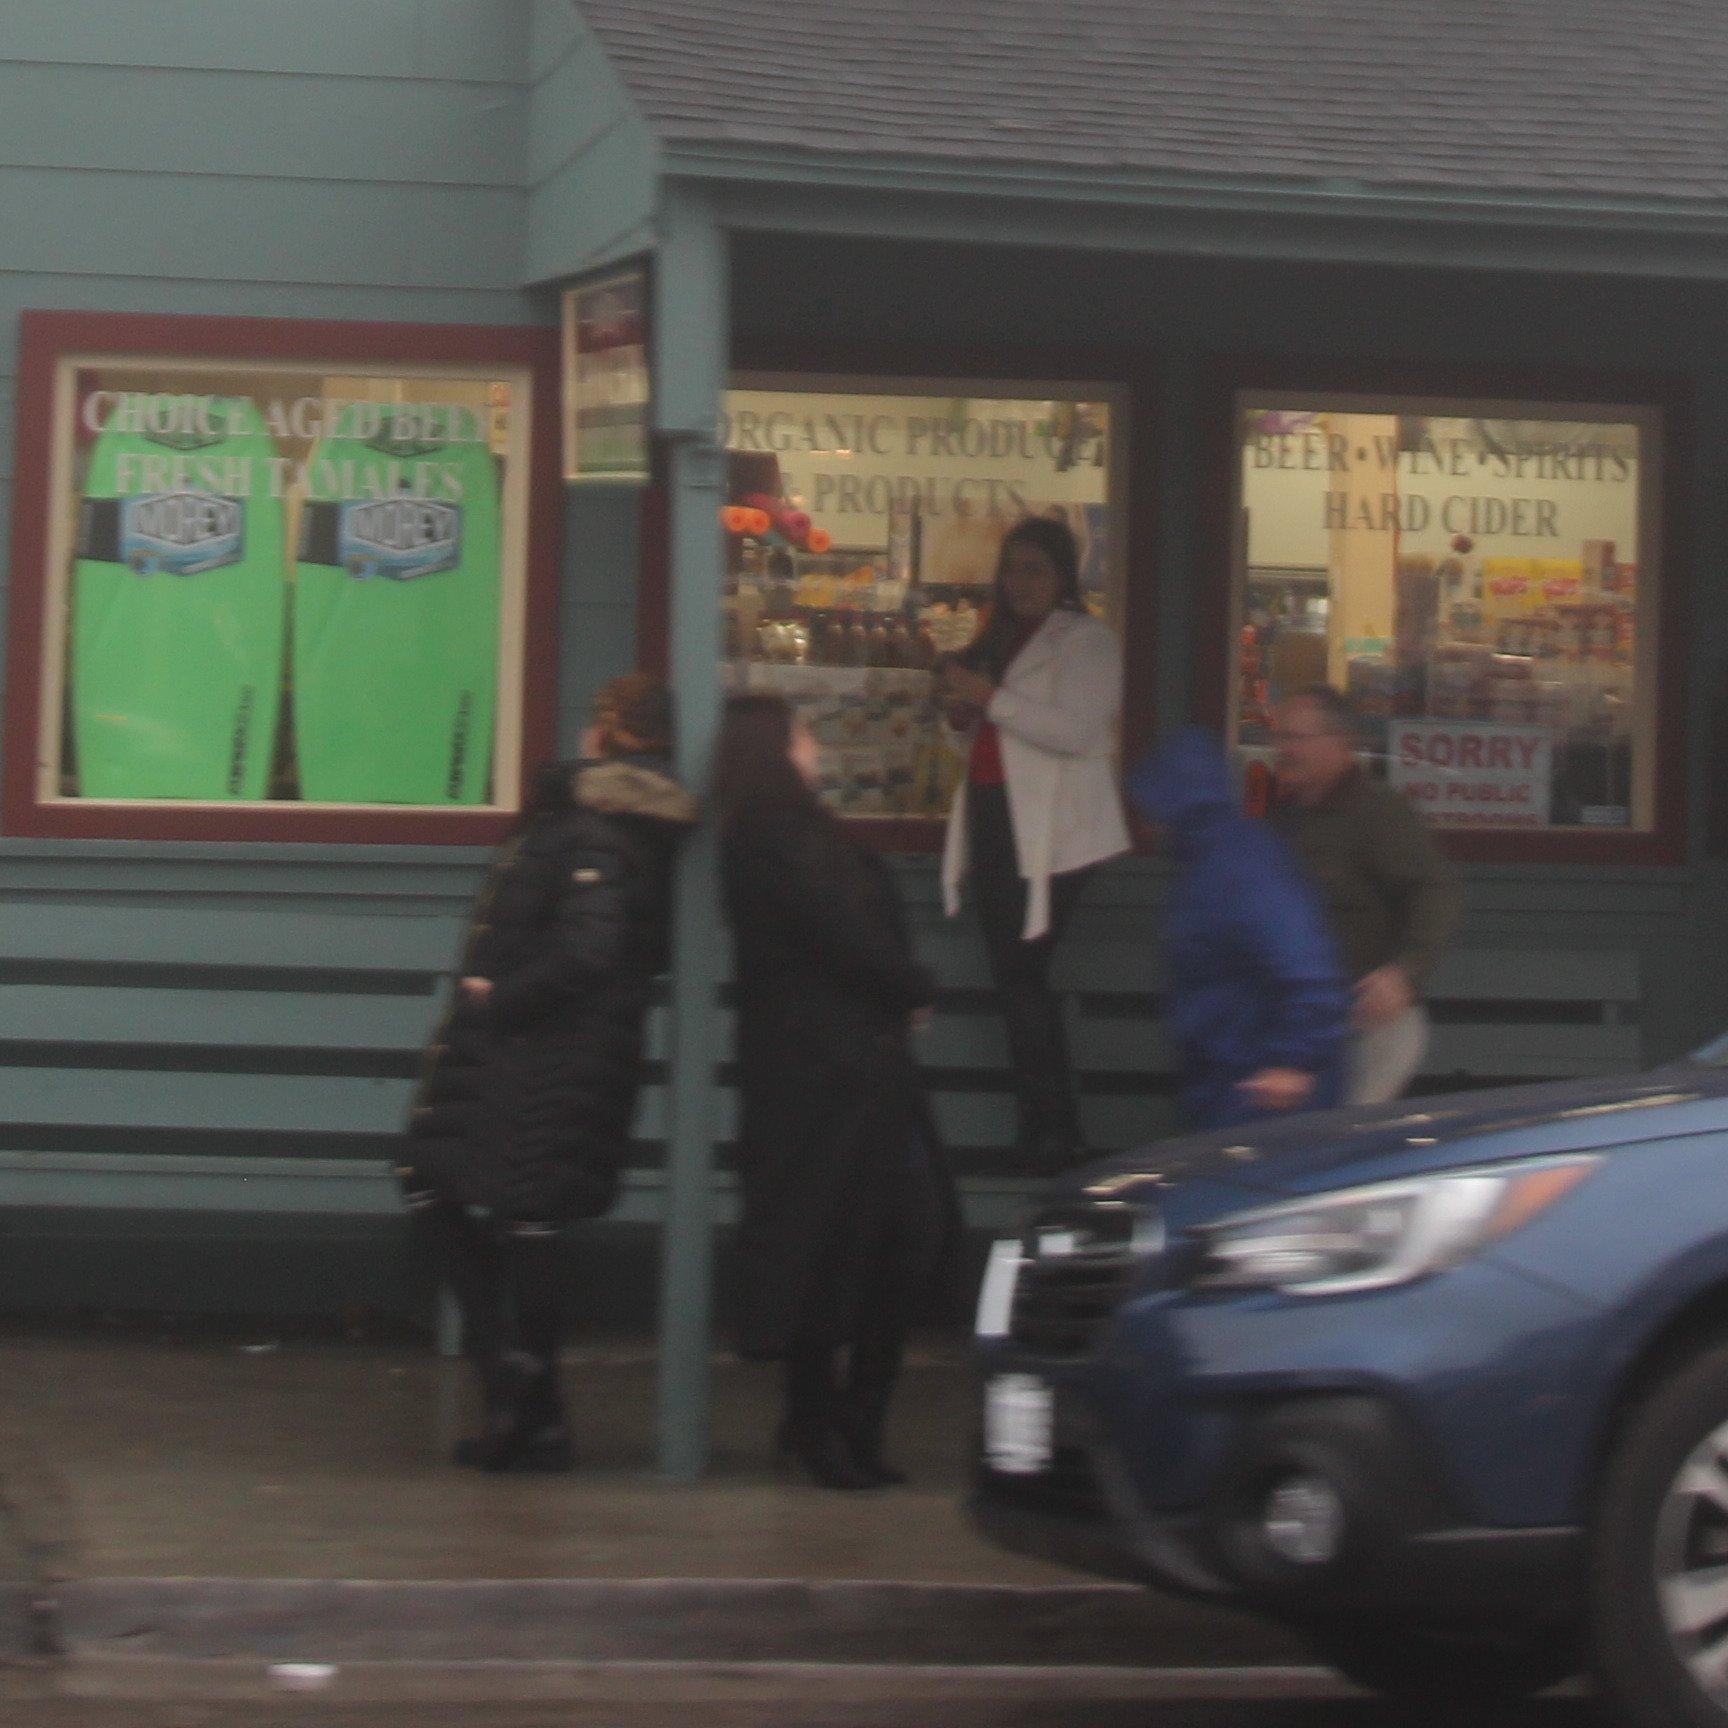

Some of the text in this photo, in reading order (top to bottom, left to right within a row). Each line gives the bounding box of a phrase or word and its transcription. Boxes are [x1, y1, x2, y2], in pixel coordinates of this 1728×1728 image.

[83, 391, 254, 435] CHOICE
[267, 398, 381, 438] AGED
[115, 454, 465, 503] FRESH TAMALES
[1252, 432, 1632, 484] BEER WINE SPIRITS
[812, 473, 1029, 518] PRODUCTS
[1322, 491, 1559, 538] HARD CIDER
[1399, 732, 1540, 771] SORRY
[1446, 782, 1531, 804] PUBLIC
